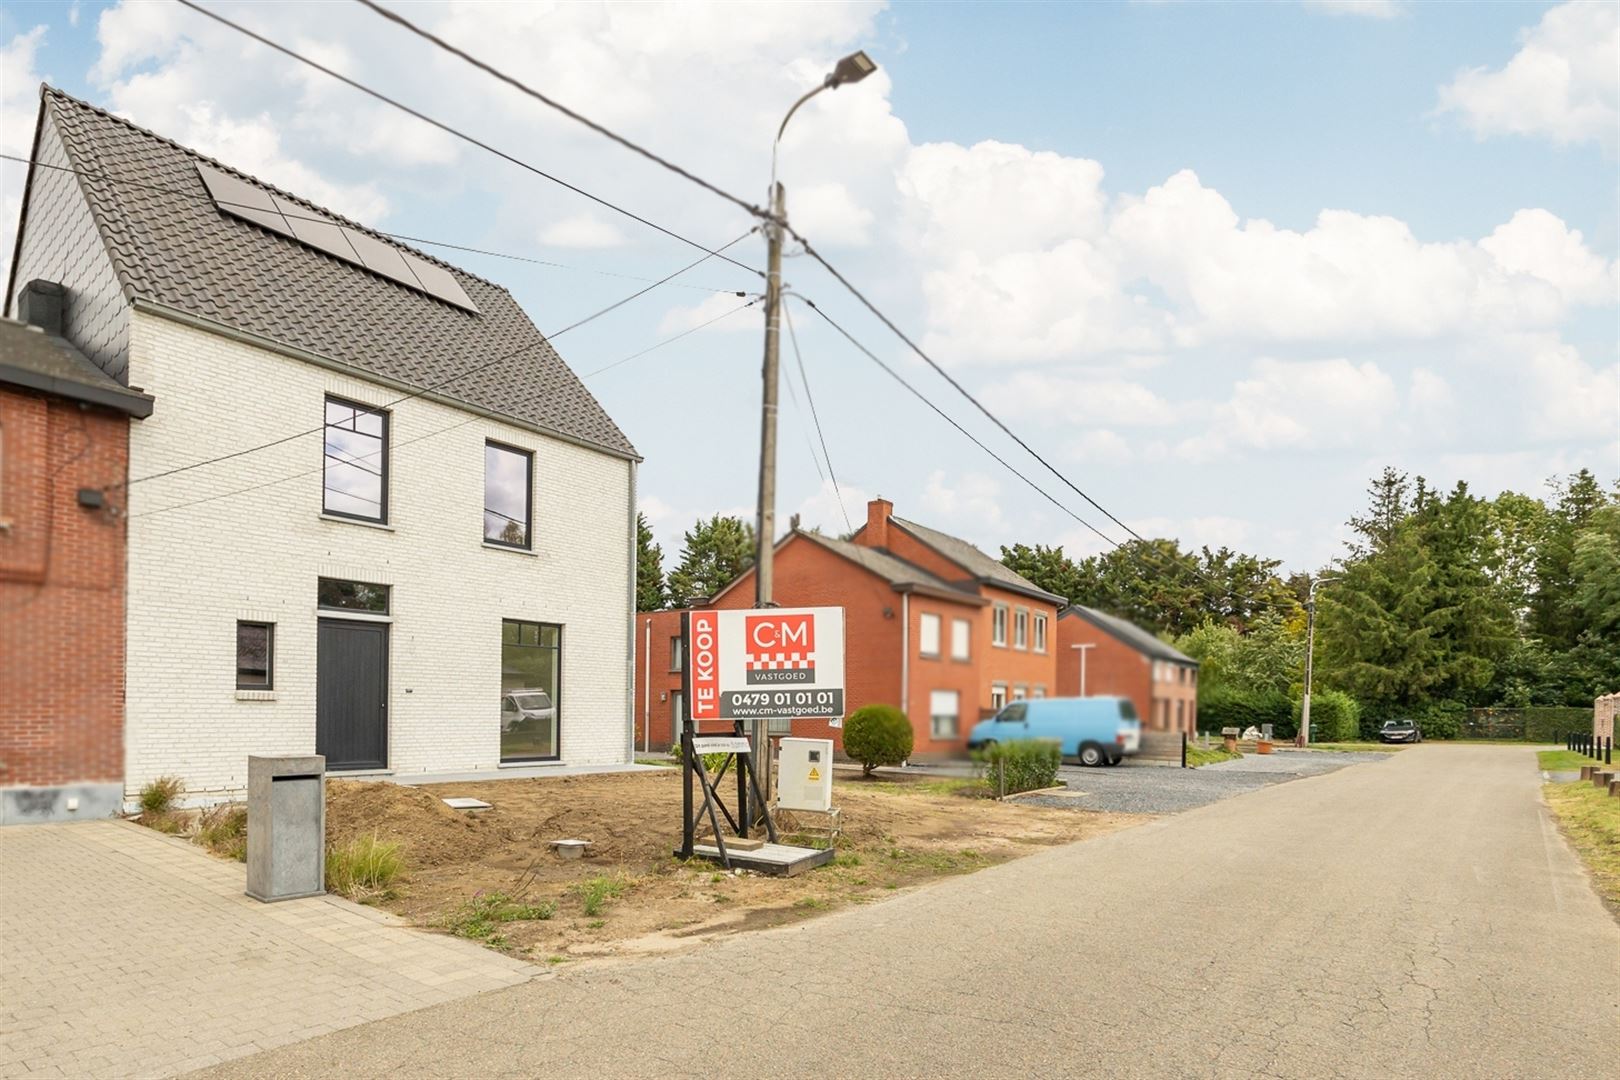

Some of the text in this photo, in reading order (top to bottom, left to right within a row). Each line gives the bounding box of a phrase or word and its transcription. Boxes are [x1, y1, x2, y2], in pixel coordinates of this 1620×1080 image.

[753, 621, 807, 648] C&M
[697, 619, 714, 714] TE KOOP
[732, 691, 833, 705] 0479 01 01 01
[733, 705, 833, 715] www.cm-vastgoed.be
